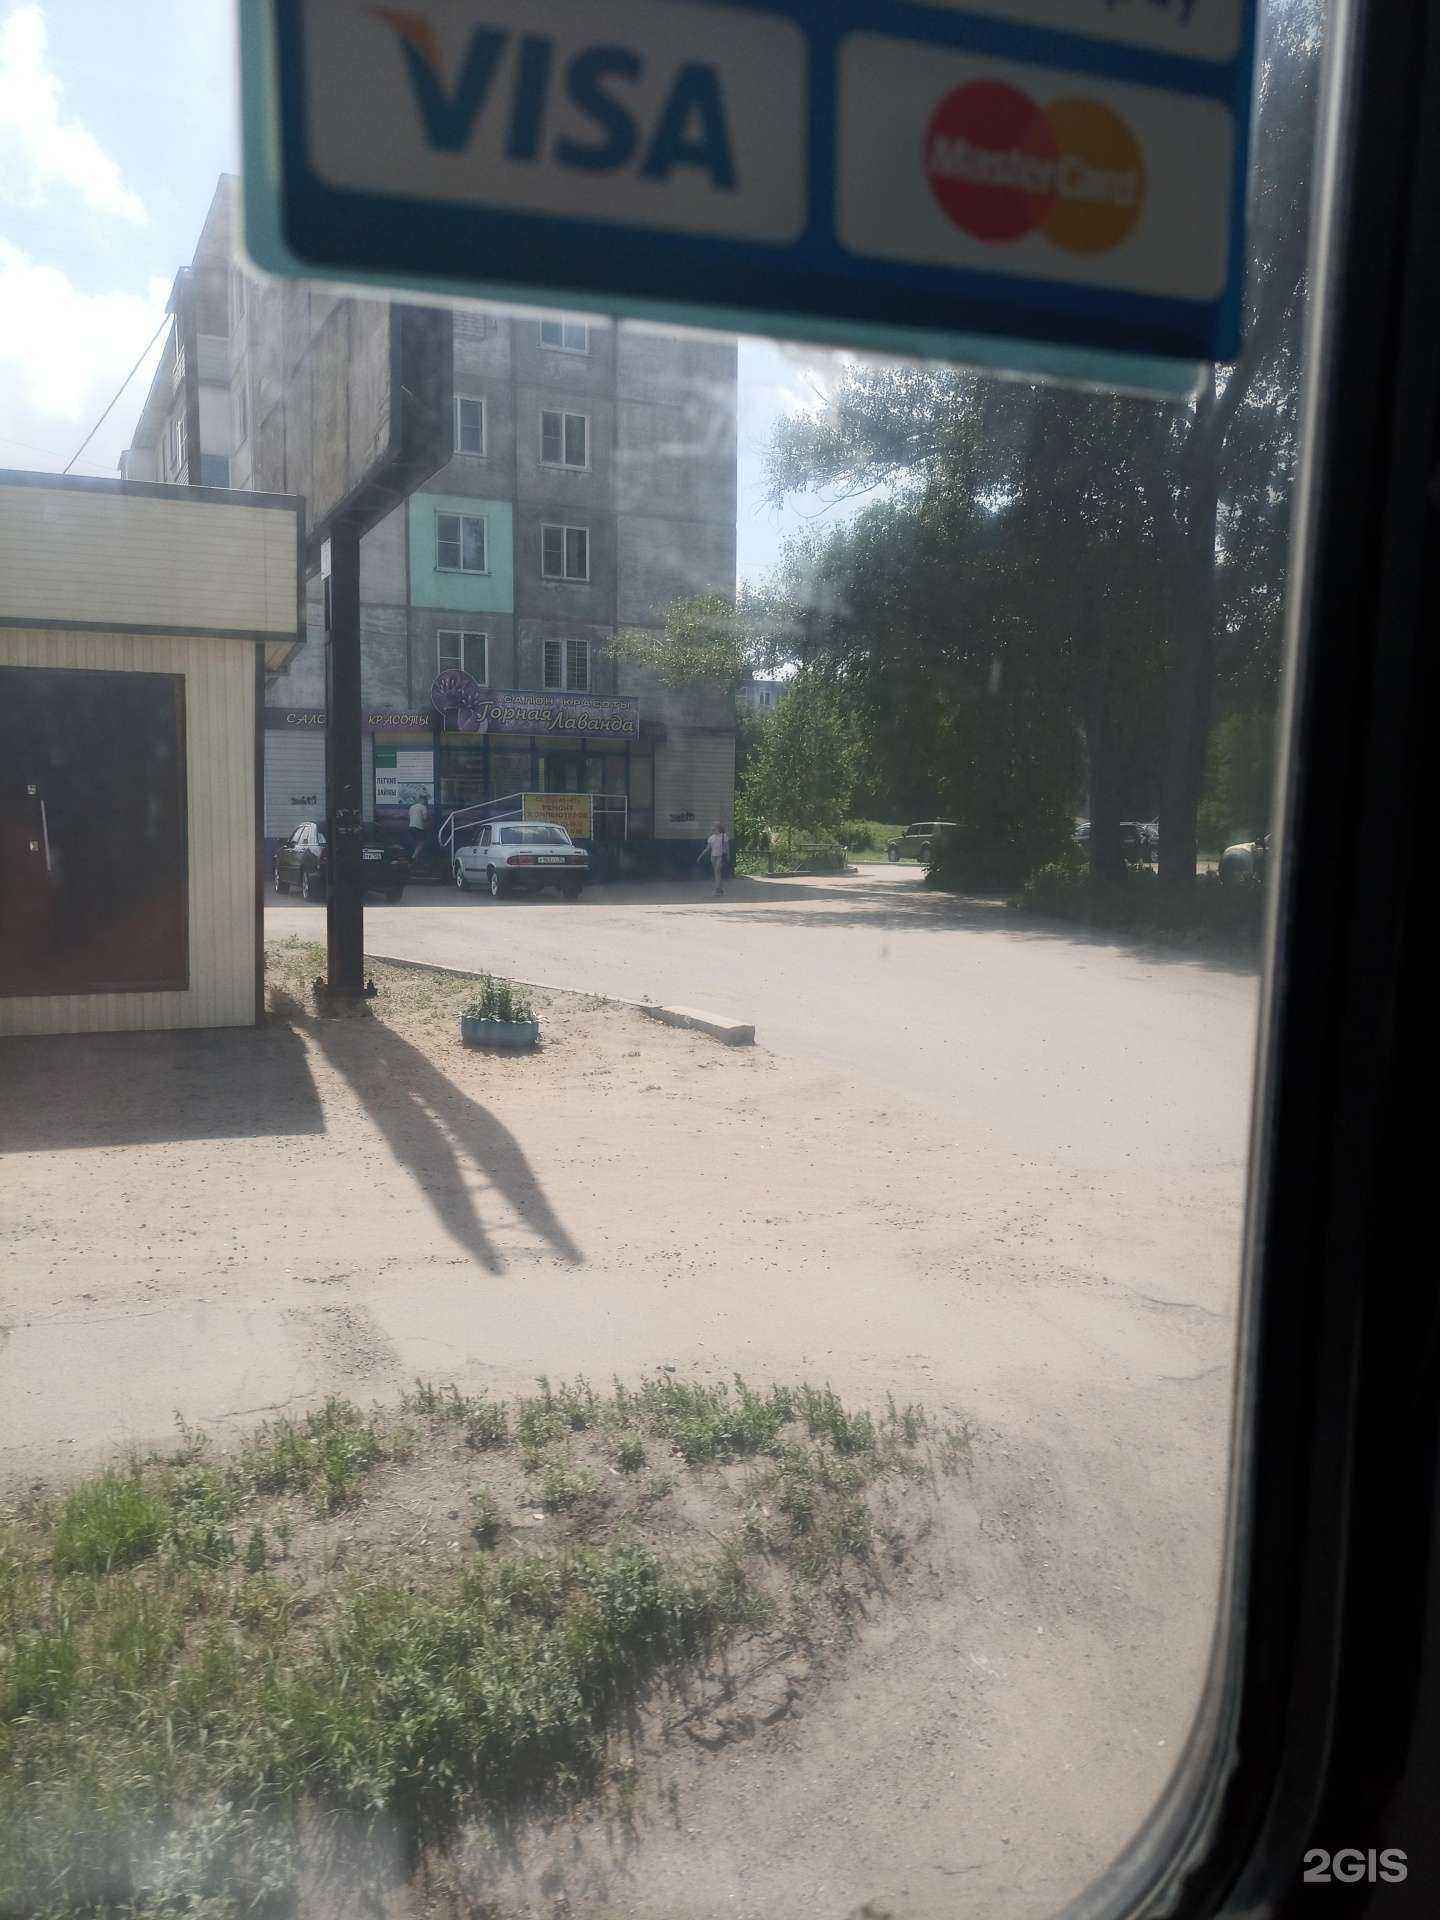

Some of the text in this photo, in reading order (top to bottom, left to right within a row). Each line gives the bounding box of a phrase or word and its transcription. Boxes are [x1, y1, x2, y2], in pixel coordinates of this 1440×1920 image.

[374, 10, 737, 193] VISA
[930, 134, 1140, 208] MasterCard
[504, 695, 553, 705] САЛОН
[286, 713, 327, 725] САЛО
[477, 702, 635, 732] Горная Лаванда
